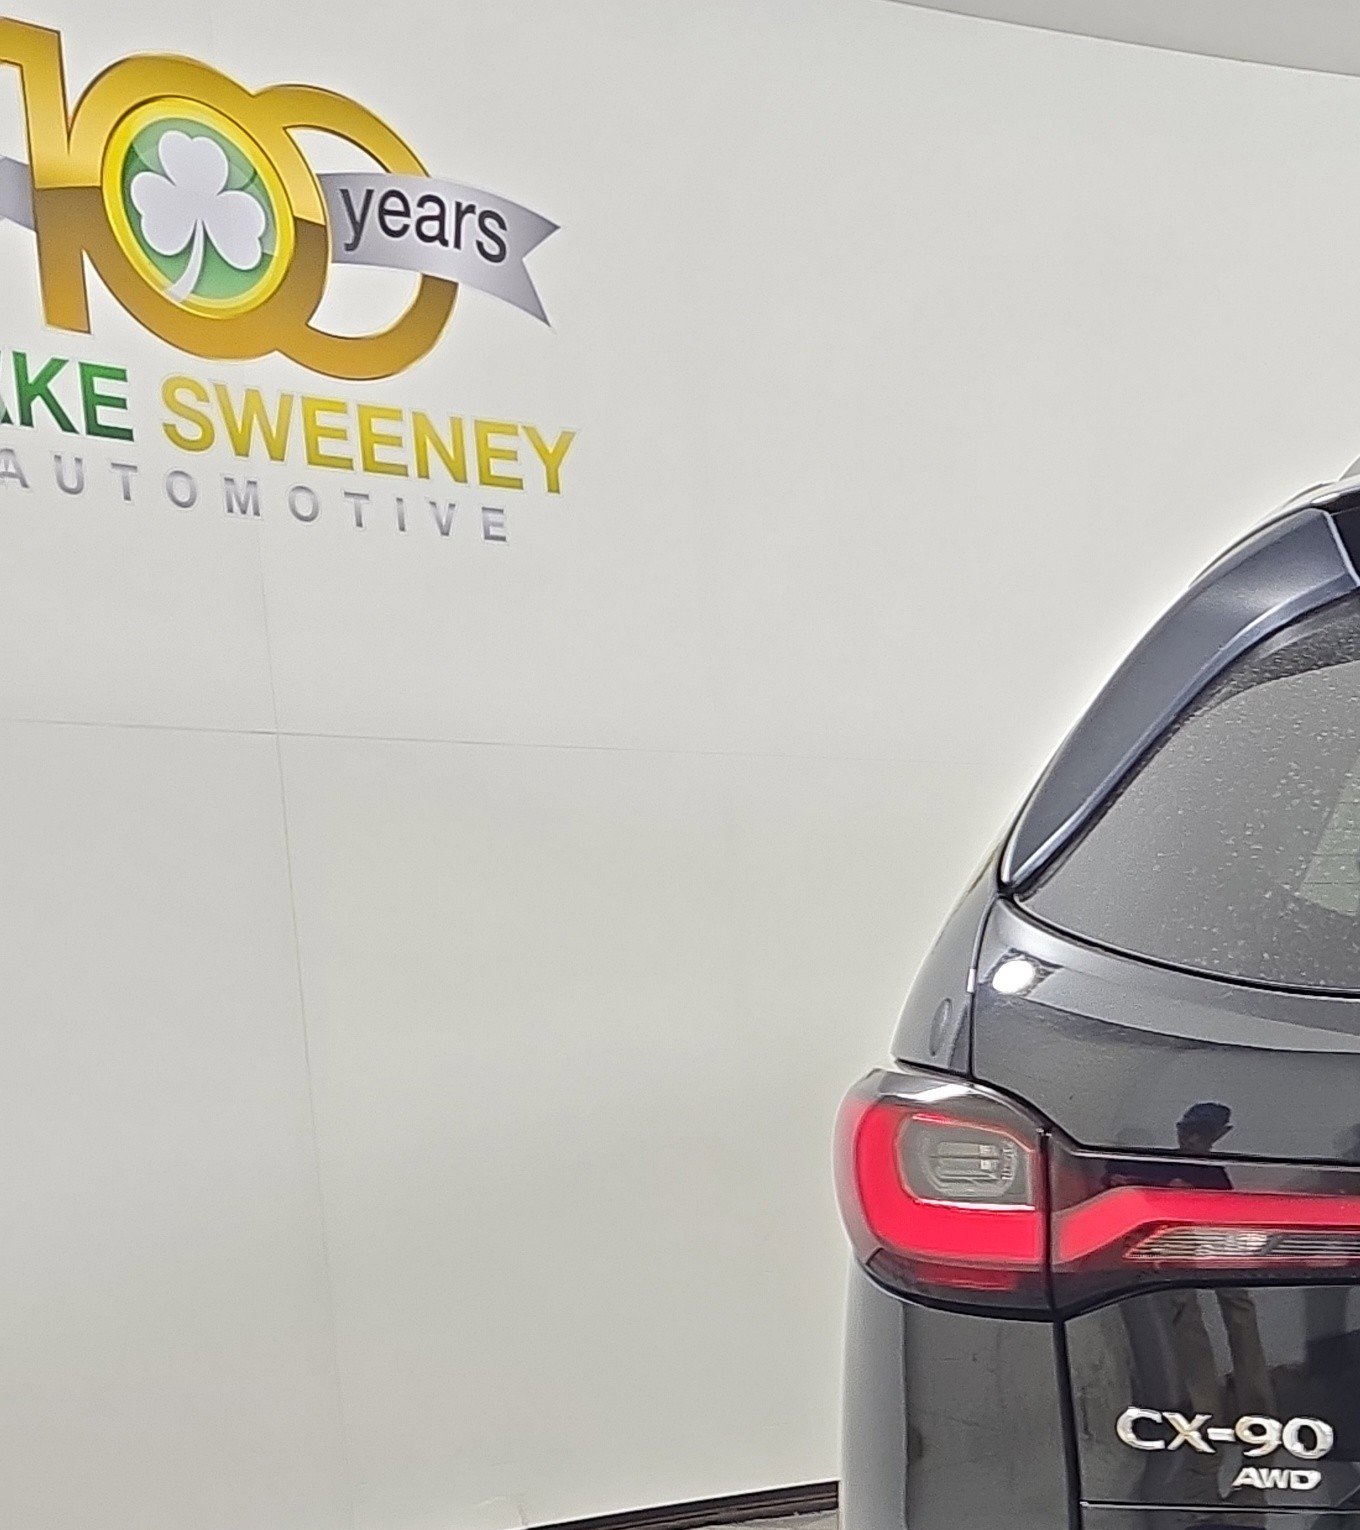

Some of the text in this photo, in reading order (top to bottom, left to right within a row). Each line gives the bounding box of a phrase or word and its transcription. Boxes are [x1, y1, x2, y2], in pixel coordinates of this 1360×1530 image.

[338, 183, 509, 265] years
[0, 350, 575, 495] KE SWEENEY
[0, 447, 508, 543] AUTOMOTIVE
[1116, 1406, 1334, 1459] CX-90
[1232, 1467, 1322, 1490] AWD
